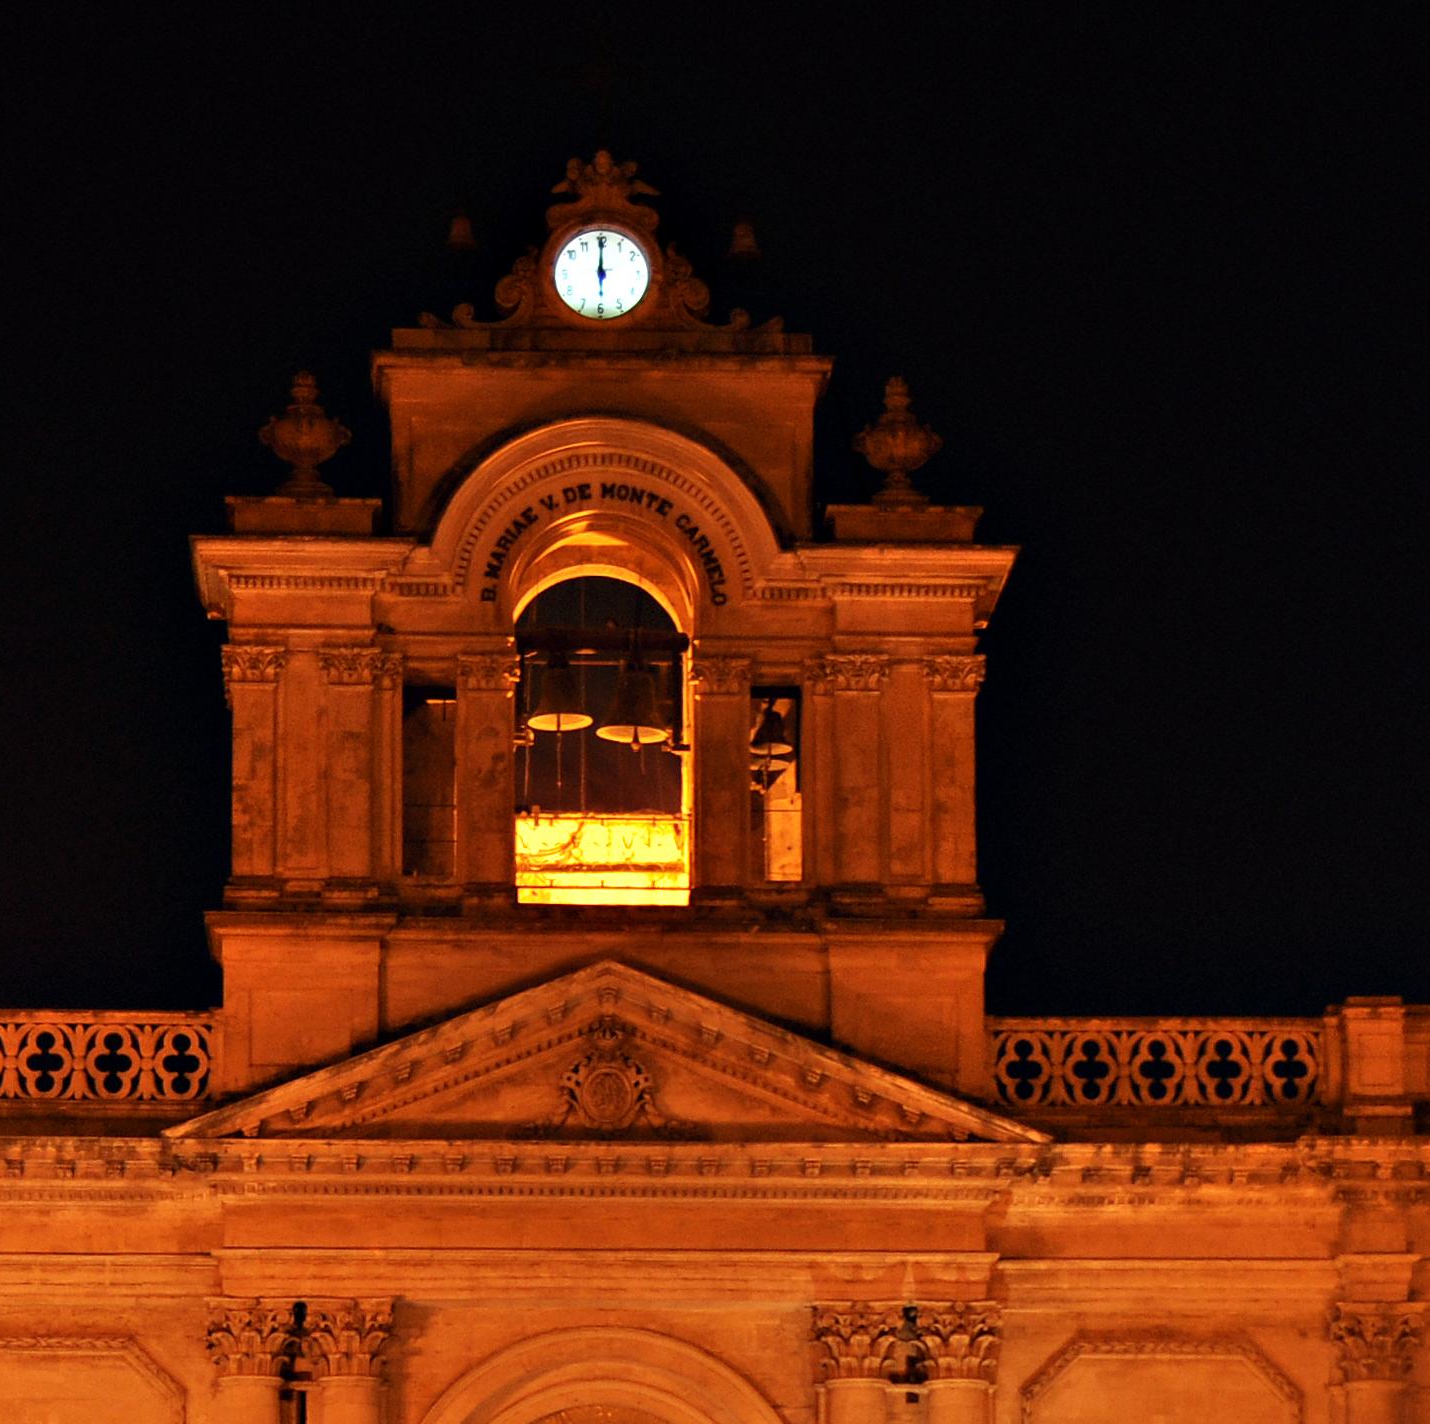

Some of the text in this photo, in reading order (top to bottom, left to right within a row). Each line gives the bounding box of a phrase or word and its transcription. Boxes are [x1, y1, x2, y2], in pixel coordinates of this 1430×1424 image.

[597, 303, 604, 314] 6
[485, 507, 539, 580] MARIAE
[539, 494, 560, 512] V.
[562, 482, 592, 504] DE
[600, 482, 674, 517] MONTE
[675, 514, 729, 607] CARMELO
